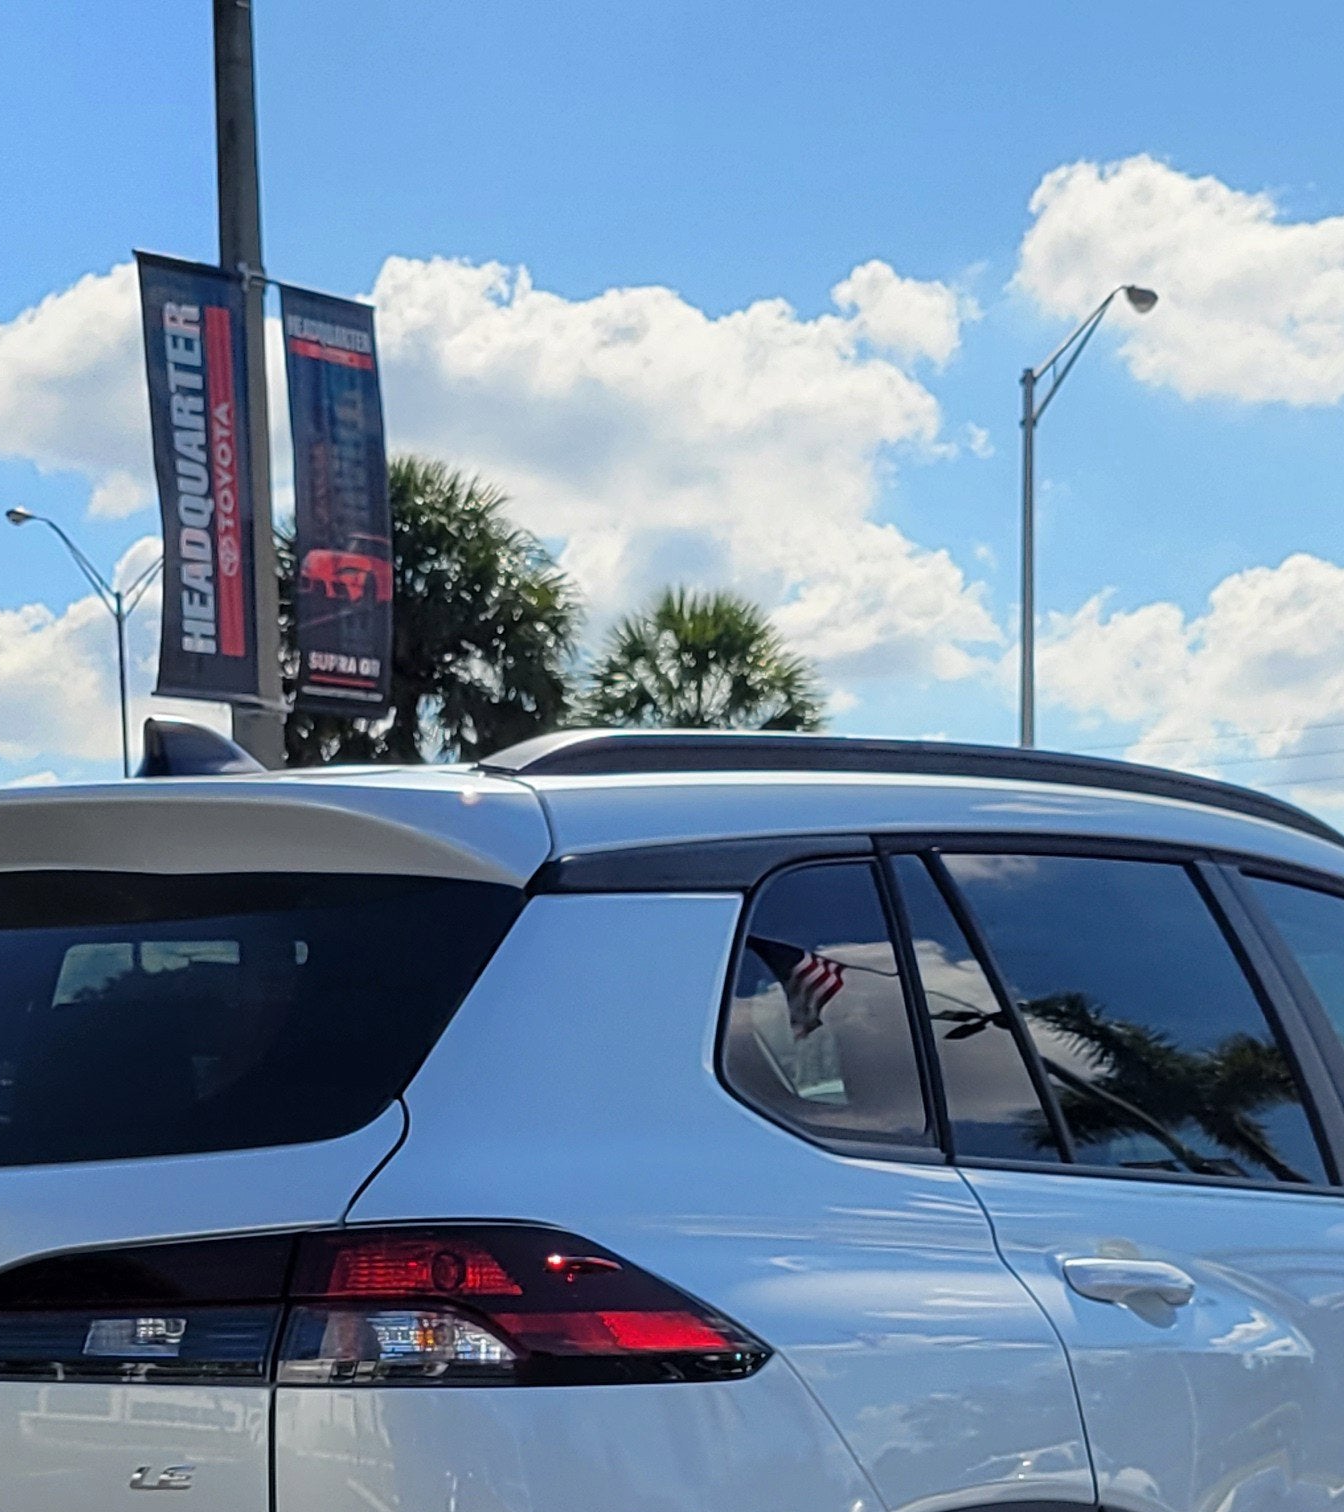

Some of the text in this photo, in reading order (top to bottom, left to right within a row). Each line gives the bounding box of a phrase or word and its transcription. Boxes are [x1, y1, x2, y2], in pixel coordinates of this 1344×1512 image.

[163, 301, 216, 655] HEADQUARTER
[213, 402, 235, 533] TOYOTA
[308, 652, 356, 674] SUPRA
[130, 1466, 195, 1490] LE
